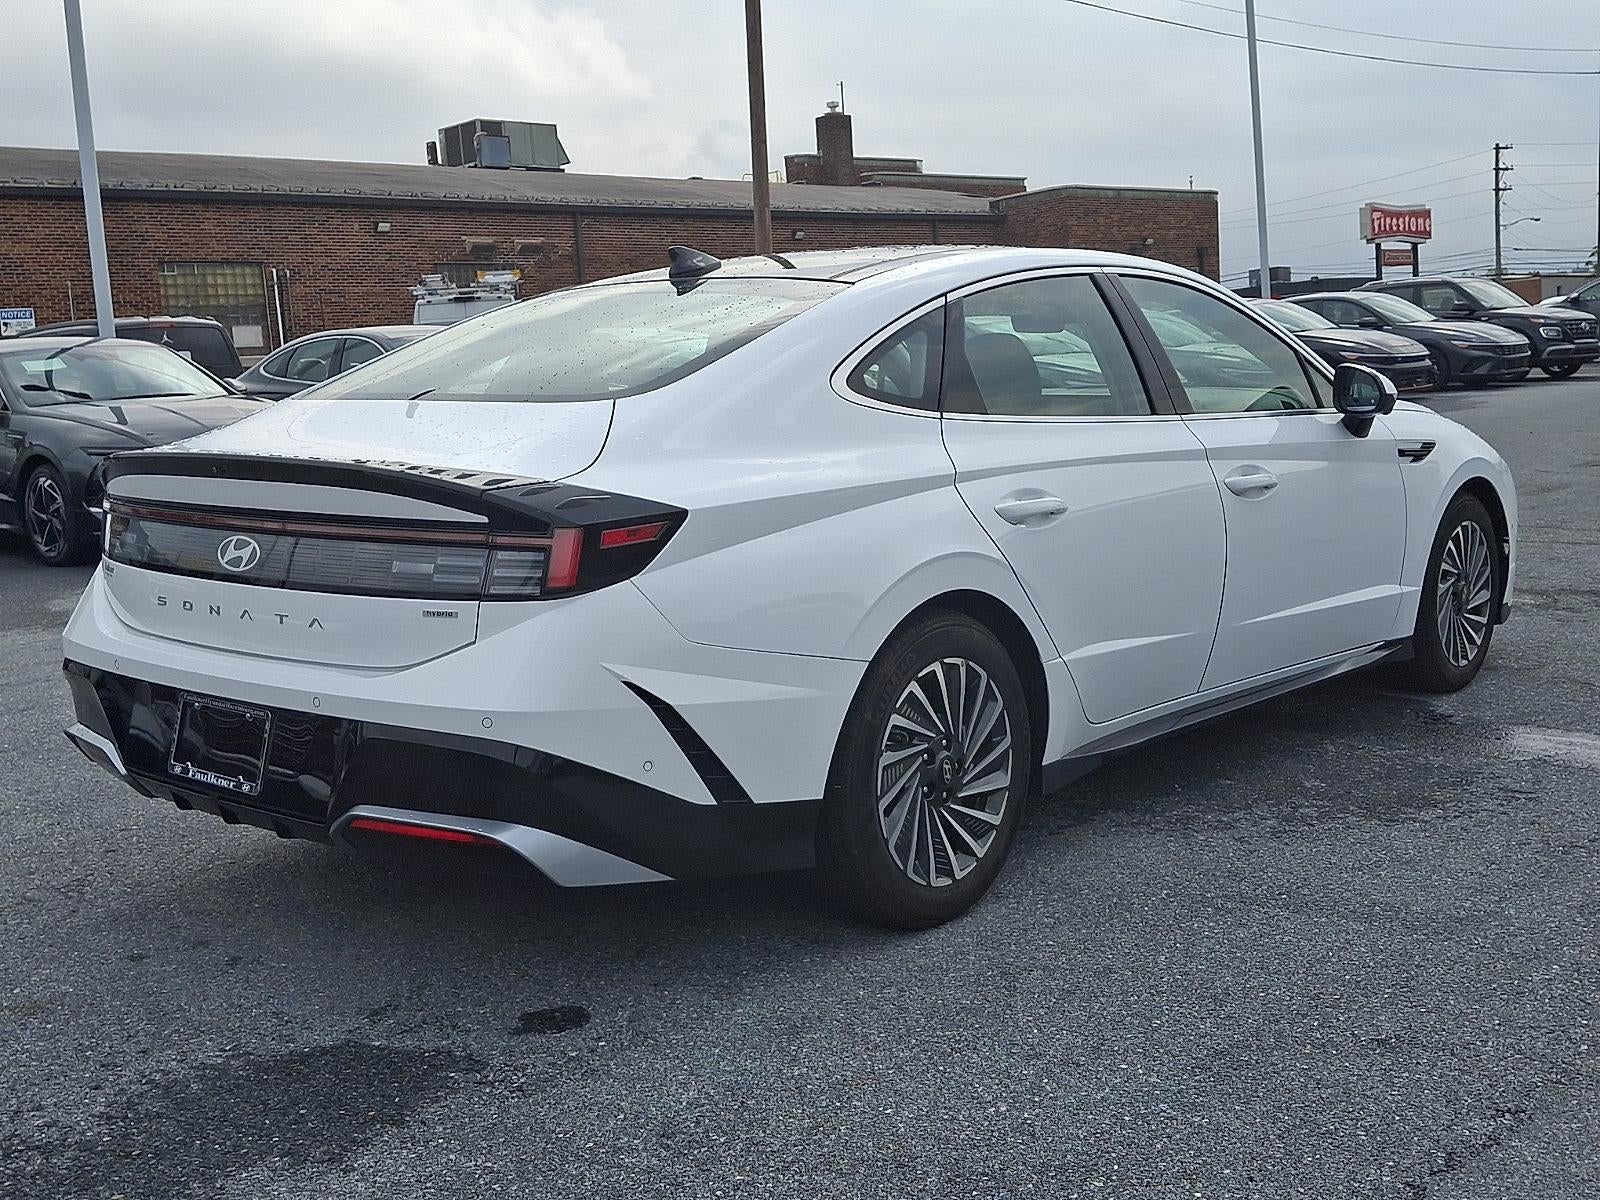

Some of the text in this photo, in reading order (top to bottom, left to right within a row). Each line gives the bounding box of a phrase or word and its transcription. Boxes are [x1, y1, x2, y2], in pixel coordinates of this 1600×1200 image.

[1372, 211, 1431, 233] Firestone
[157, 595, 324, 630] SONATA
[188, 769, 237, 789] Faulkner
